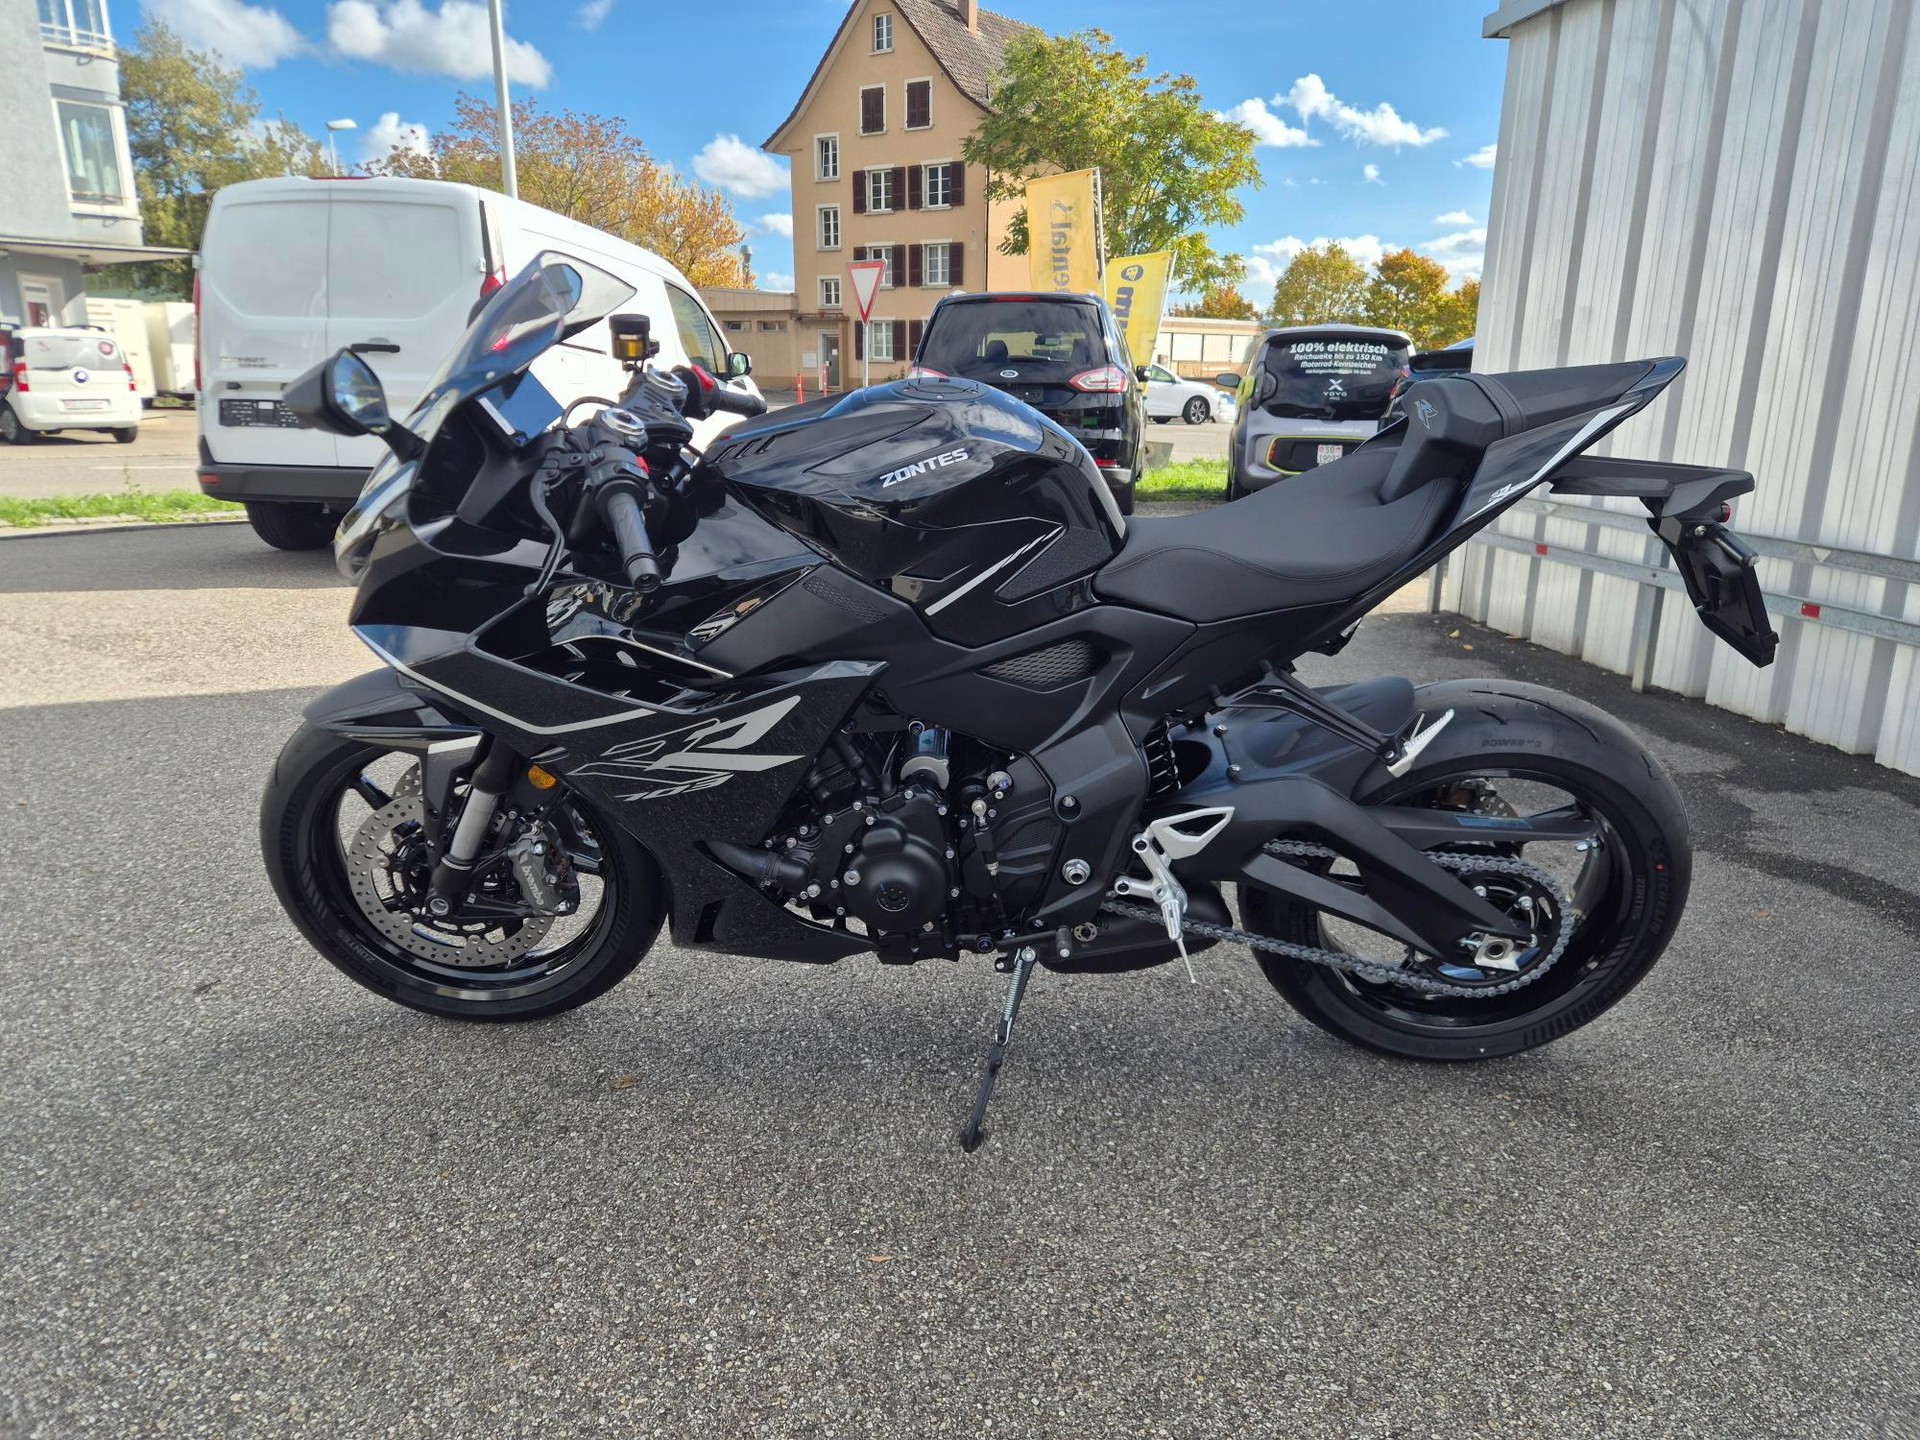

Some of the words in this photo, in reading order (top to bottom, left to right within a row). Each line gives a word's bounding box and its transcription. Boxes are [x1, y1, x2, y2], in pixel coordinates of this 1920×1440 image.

[1289, 342, 1325, 354] 100%
[1327, 342, 1389, 355] elektrisch
[1294, 353, 1333, 361] Reichweite
[1333, 352, 1345, 360] bis
[1356, 353, 1371, 361] 150
[1371, 353, 1383, 362] Km
[1300, 361, 1377, 370] Motorrad-Kennzeichen
[879, 447, 970, 488] ZONTES
[521, 865, 544, 906] brembo
[335, 927, 376, 962] ZONTES
